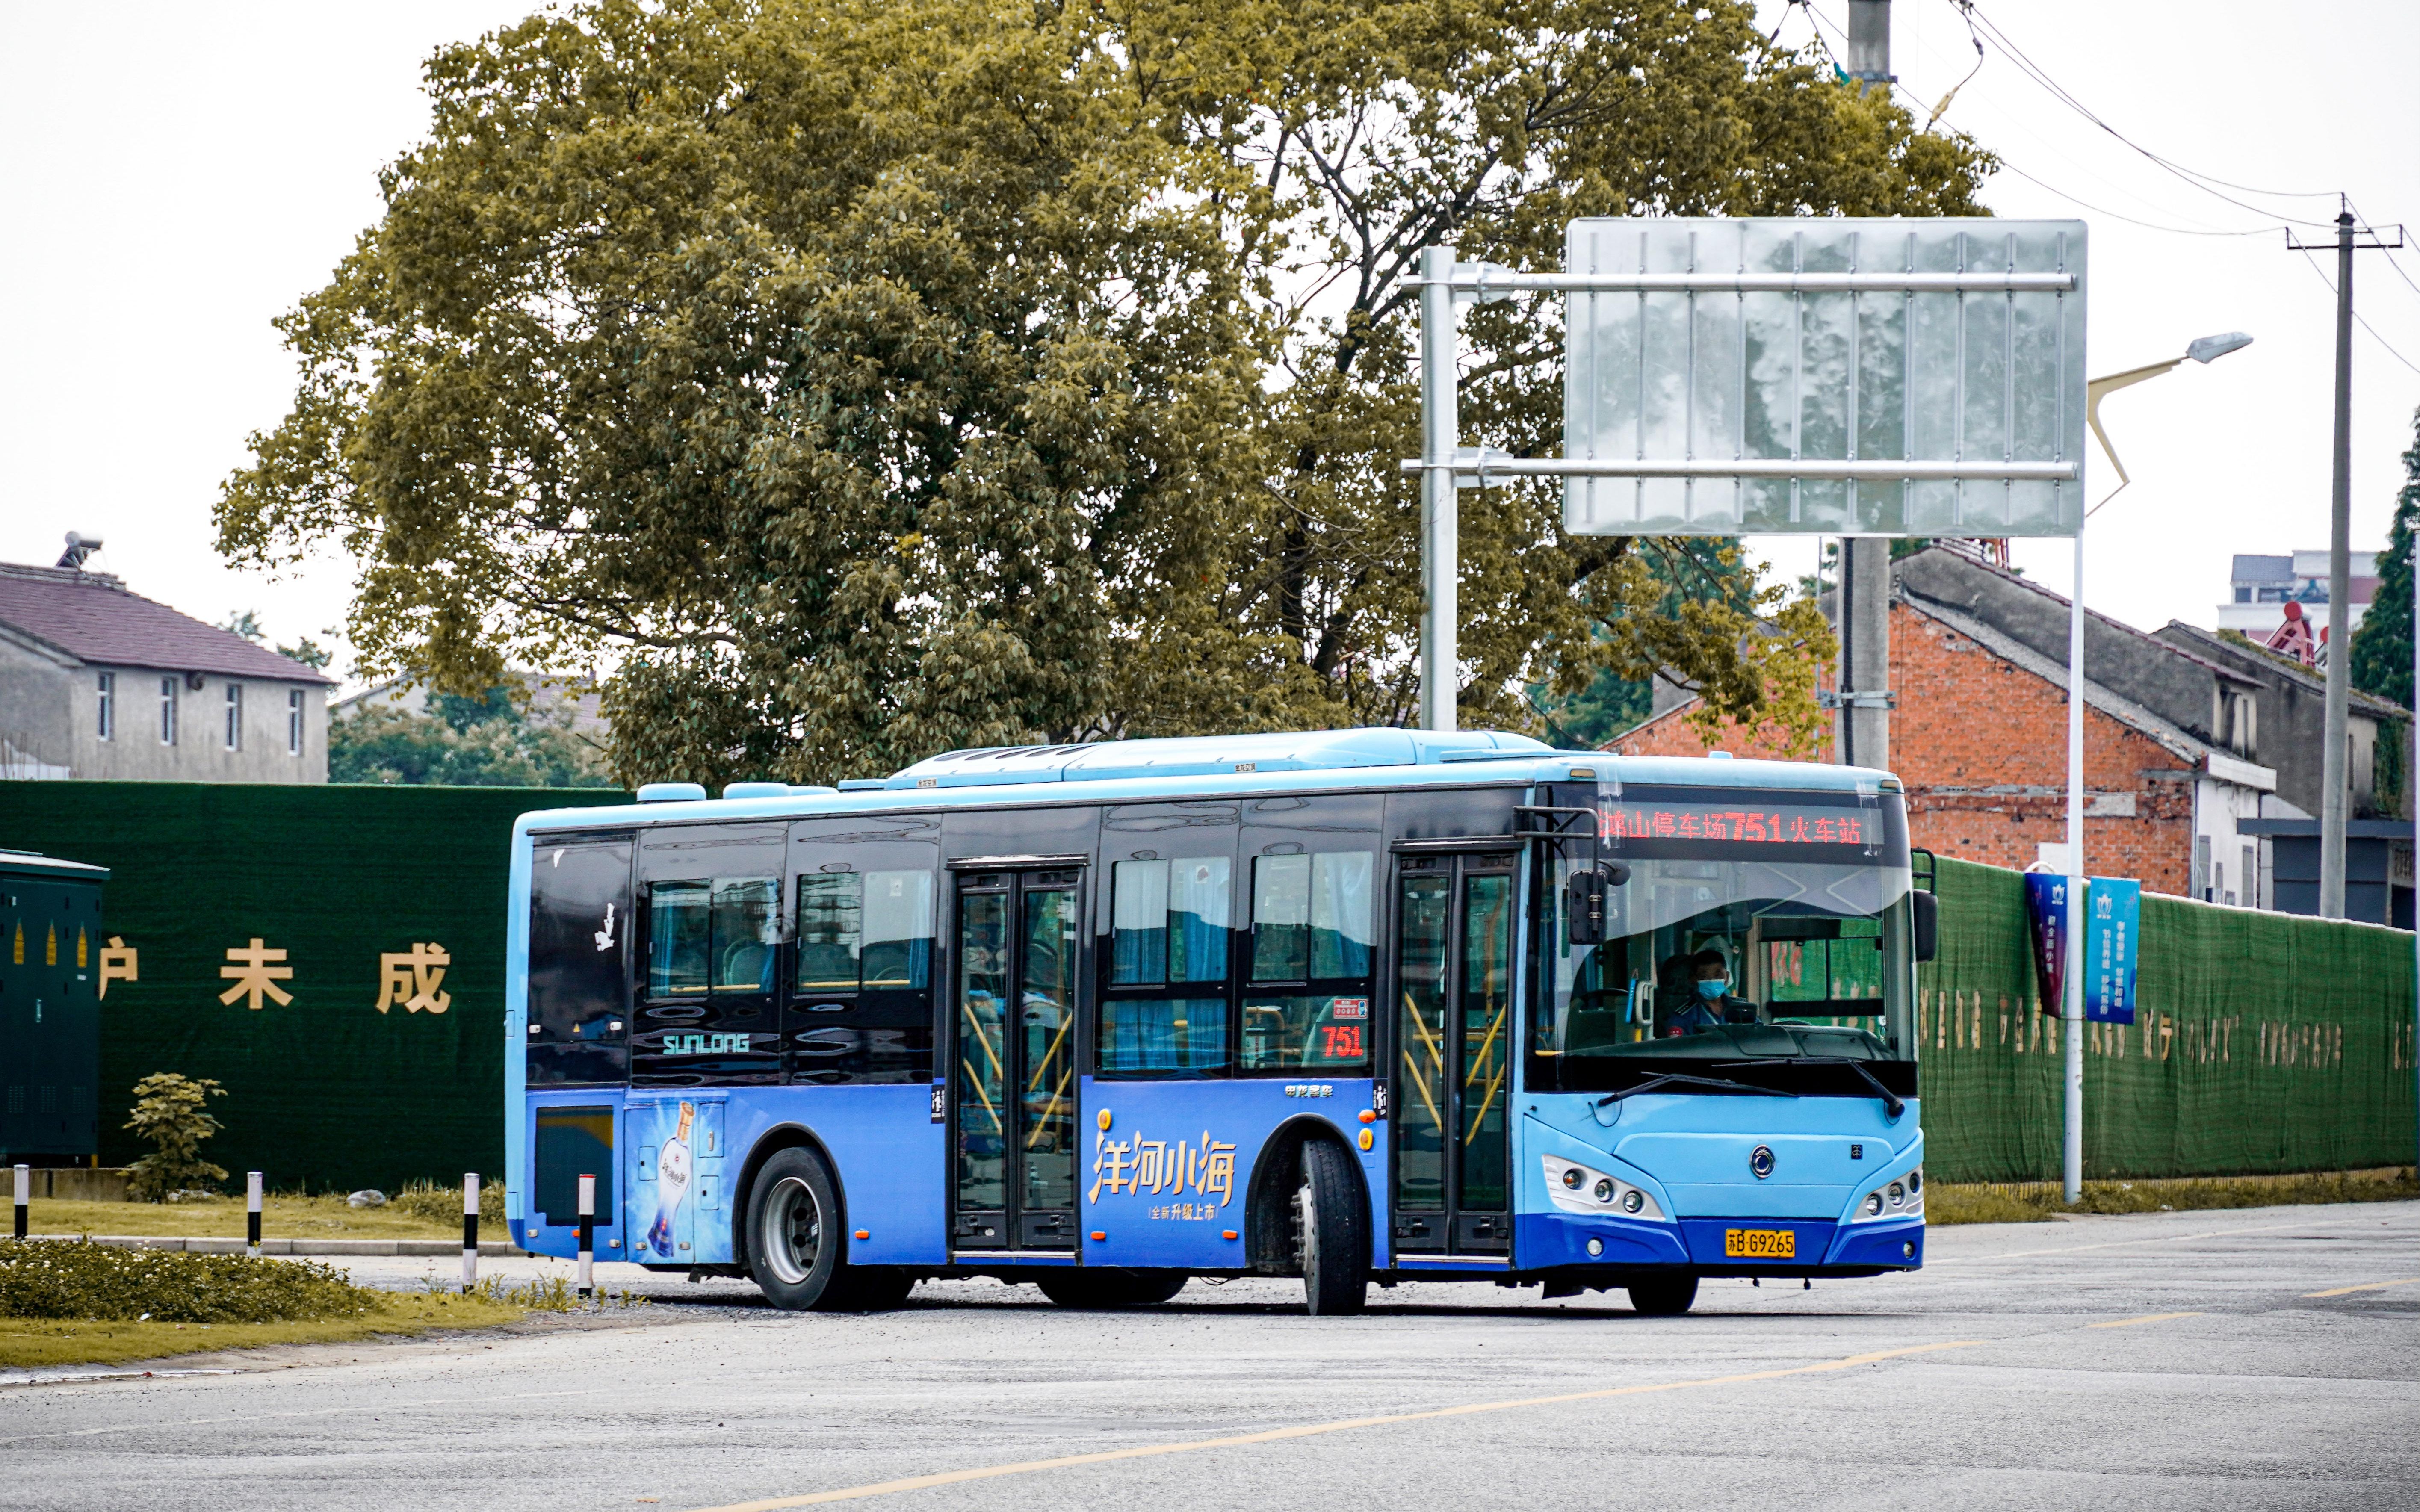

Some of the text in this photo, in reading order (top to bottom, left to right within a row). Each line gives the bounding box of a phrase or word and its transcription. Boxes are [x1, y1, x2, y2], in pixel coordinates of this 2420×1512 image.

[1725, 812, 1786, 842] 751
[1791, 815, 1861, 844] 火车站
[663, 1033, 750, 1055] SUNLONG
[1322, 1026, 1363, 1057] 751
[1285, 1084, 1333, 1098] 申龙客车
[1088, 1130, 1237, 1208] 洋河小海
[1151, 1203, 1215, 1221] 全新升级上市
